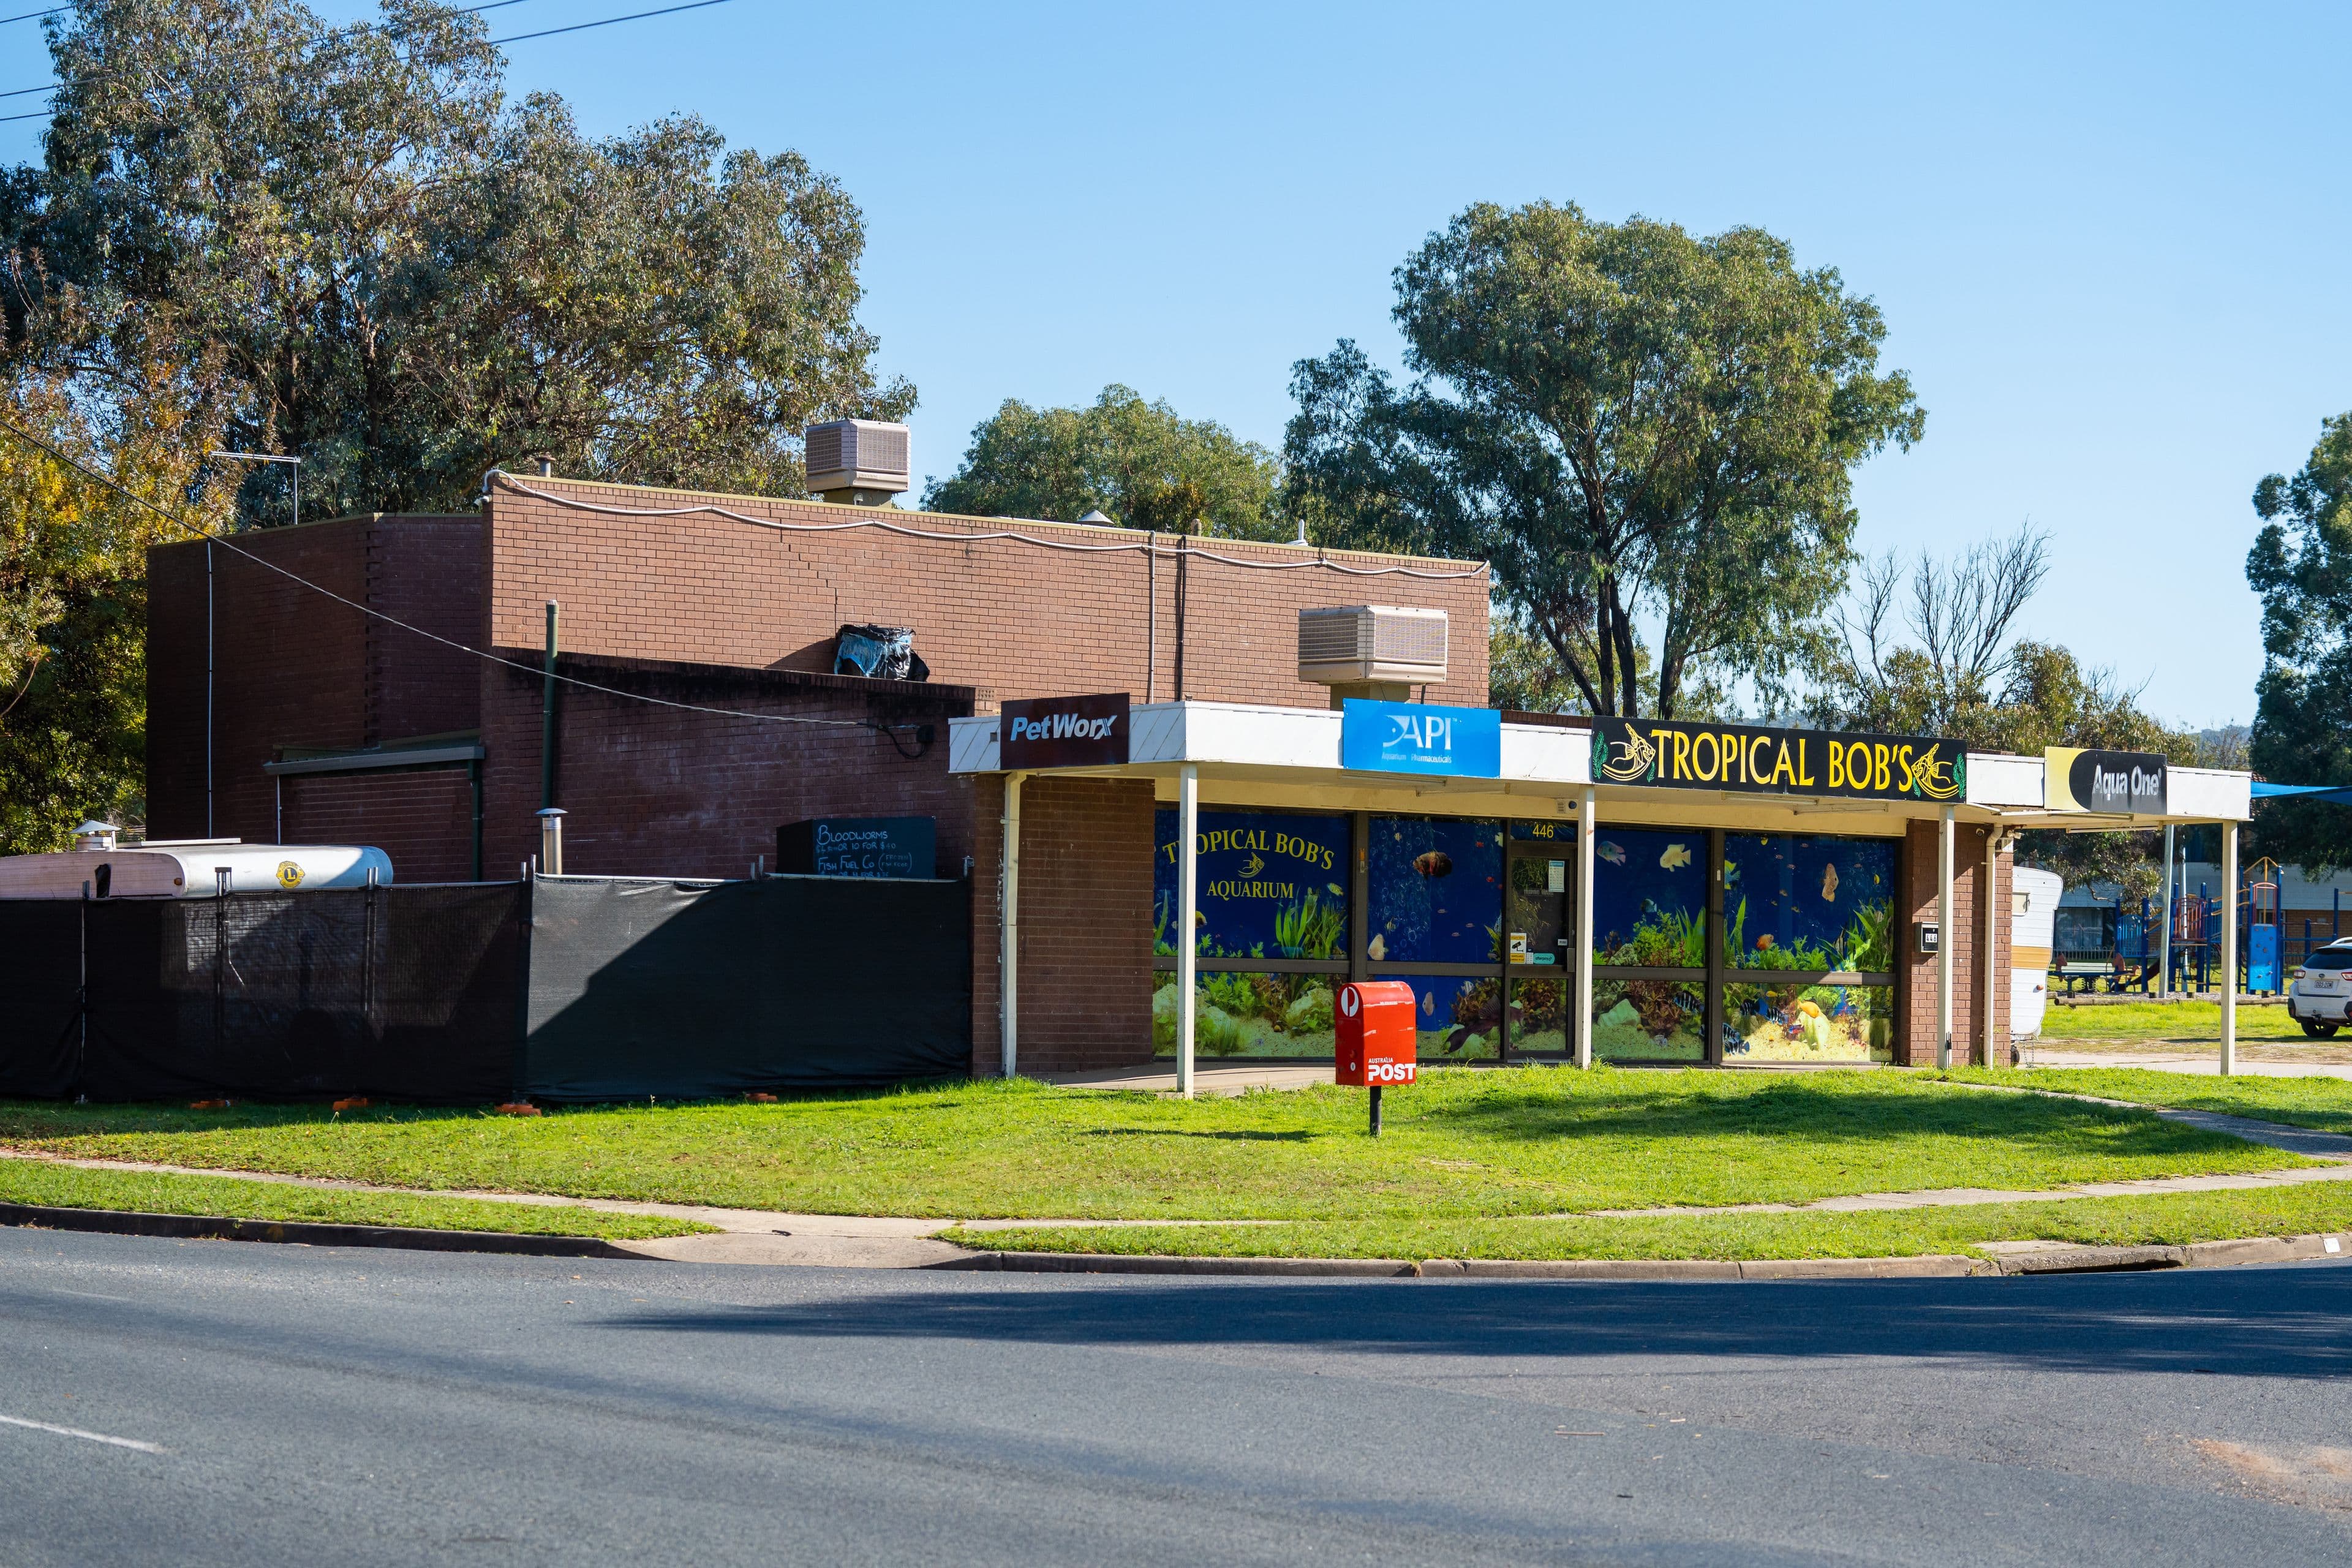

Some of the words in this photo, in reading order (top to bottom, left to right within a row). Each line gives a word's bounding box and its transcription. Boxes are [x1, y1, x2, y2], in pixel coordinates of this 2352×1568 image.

[1011, 713, 1118, 741] PetWorx
[1383, 715, 1451, 750] API
[1382, 752, 1406, 761] Aquarium
[1411, 753, 1452, 764] Pharmaceuticals
[1651, 729, 1815, 786] TROPICAL
[1828, 740, 1913, 792] BOB'S
[2092, 764, 2128, 801] Aqua
[816, 824, 888, 845] BLOODWORMS
[1532, 823, 1554, 839] 446
[1163, 829, 1270, 864] TOPICAL
[1275, 832, 1335, 870] BOB'S
[1206, 880, 1294, 901] AQUARIUM
[1368, 1063, 1416, 1082] POST
